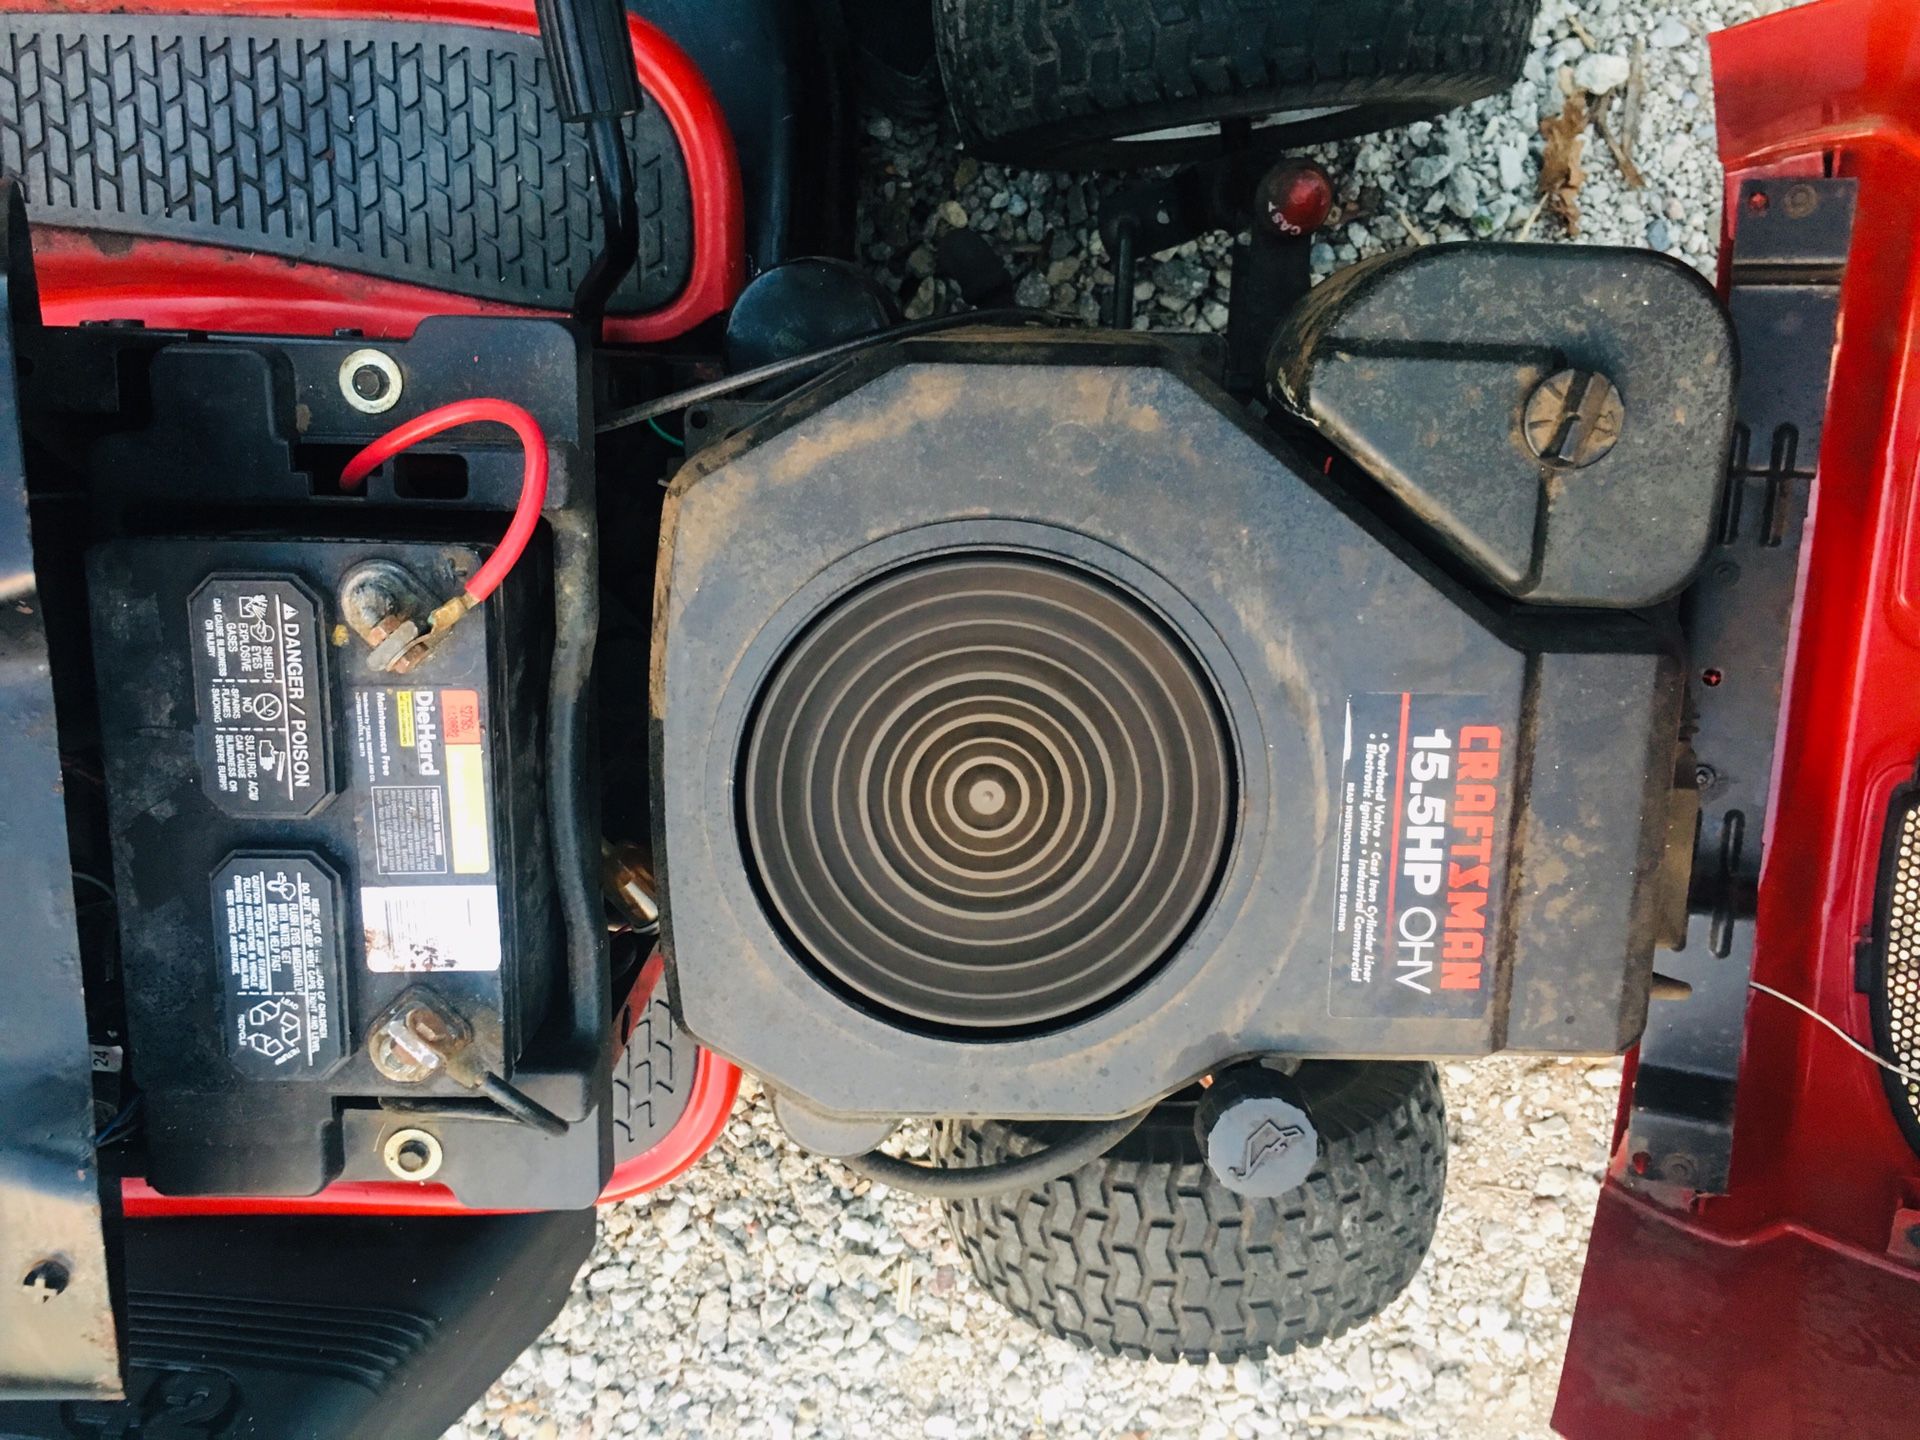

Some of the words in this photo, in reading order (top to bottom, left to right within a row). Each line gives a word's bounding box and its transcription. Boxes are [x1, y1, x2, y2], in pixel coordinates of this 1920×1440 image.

[212, 597, 222, 613] CAN
[204, 619, 213, 630] OR
[214, 613, 223, 637] CAUSE
[225, 622, 238, 652] GASES
[205, 631, 215, 657] INJURY
[216, 638, 227, 676] BLINDNESS
[238, 622, 251, 672] EXPLOSIVE
[251, 645, 262, 669] EYES
[262, 645, 274, 678] SHIELD
[283, 623, 304, 699] DANGER
[211, 687, 221, 723] SMOKING
[221, 688, 231, 718] FLAMES
[230, 687, 240, 719] SPARKS
[241, 696, 252, 713] NO
[375, 691, 389, 753] Maintenance
[414, 689, 439, 775] DieHard
[214, 733, 225, 763] SEVERE
[225, 734, 235, 777] BLINDNESS
[235, 734, 243, 750] CAN
[290, 719, 310, 788] POISON
[236, 752, 245, 778] CAUSE
[244, 734, 256, 778] SULFURIC
[381, 755, 391, 776] Free
[1362, 743, 1377, 798] Electronic
[1374, 742, 1390, 801] Overhead
[228, 779, 236, 792] OR
[1345, 782, 1354, 803] READ
[1356, 800, 1372, 844] Ignition
[1372, 804, 1385, 837] Valve
[1401, 727, 1451, 896] 15.5HP
[1342, 805, 1353, 862] INSTRUCTIONS
[1369, 851, 1381, 877] Cast
[1439, 723, 1502, 991] CRAFTSMAN
[242, 877, 252, 904] FOLLOW
[301, 882, 309, 893] DO
[1339, 863, 1349, 891] BEFORE
[1354, 858, 1368, 913] Industrial
[1367, 879, 1379, 902] Iron
[225, 889, 234, 906] SEEK
[302, 895, 310, 911] NOT
[227, 907, 236, 933] SERVICE
[253, 906, 262, 920] FOR
[267, 903, 278, 933] MEDICAL
[278, 903, 288, 921] WITH
[288, 902, 299, 926] FLUSH
[1337, 893, 1347, 931] STARTING
[244, 905, 255, 951] INSTRUCTIONS
[254, 921, 263, 937] SAFE
[290, 927, 300, 945] EYES
[304, 929, 313, 947] KEEP
[312, 918, 321, 934] OUT
[1361, 905, 1378, 952] Cylinder
[238, 941, 247, 955] NOT
[255, 938, 264, 957] JUMP
[269, 935, 279, 953] HELP
[280, 949, 291, 964] GET
[1350, 915, 1365, 982] Commercial
[1393, 905, 1437, 993] OHV
[271, 954, 281, 972] FAST
[291, 946, 303, 992] IMMEDIATELY
[305, 949, 314, 968] VENT
[1362, 954, 1374, 982] Liner
[239, 957, 249, 989] AVAILABLE
[248, 961, 257, 986] VEHICLE
[257, 958, 266, 989] STARTING
[307, 970, 315, 989] CAPS
[317, 990, 325, 1001] OF
[236, 1014, 246, 1046] RECYCLE
[310, 1014, 318, 1029] AND
[317, 1002, 327, 1038] CHILDREN
